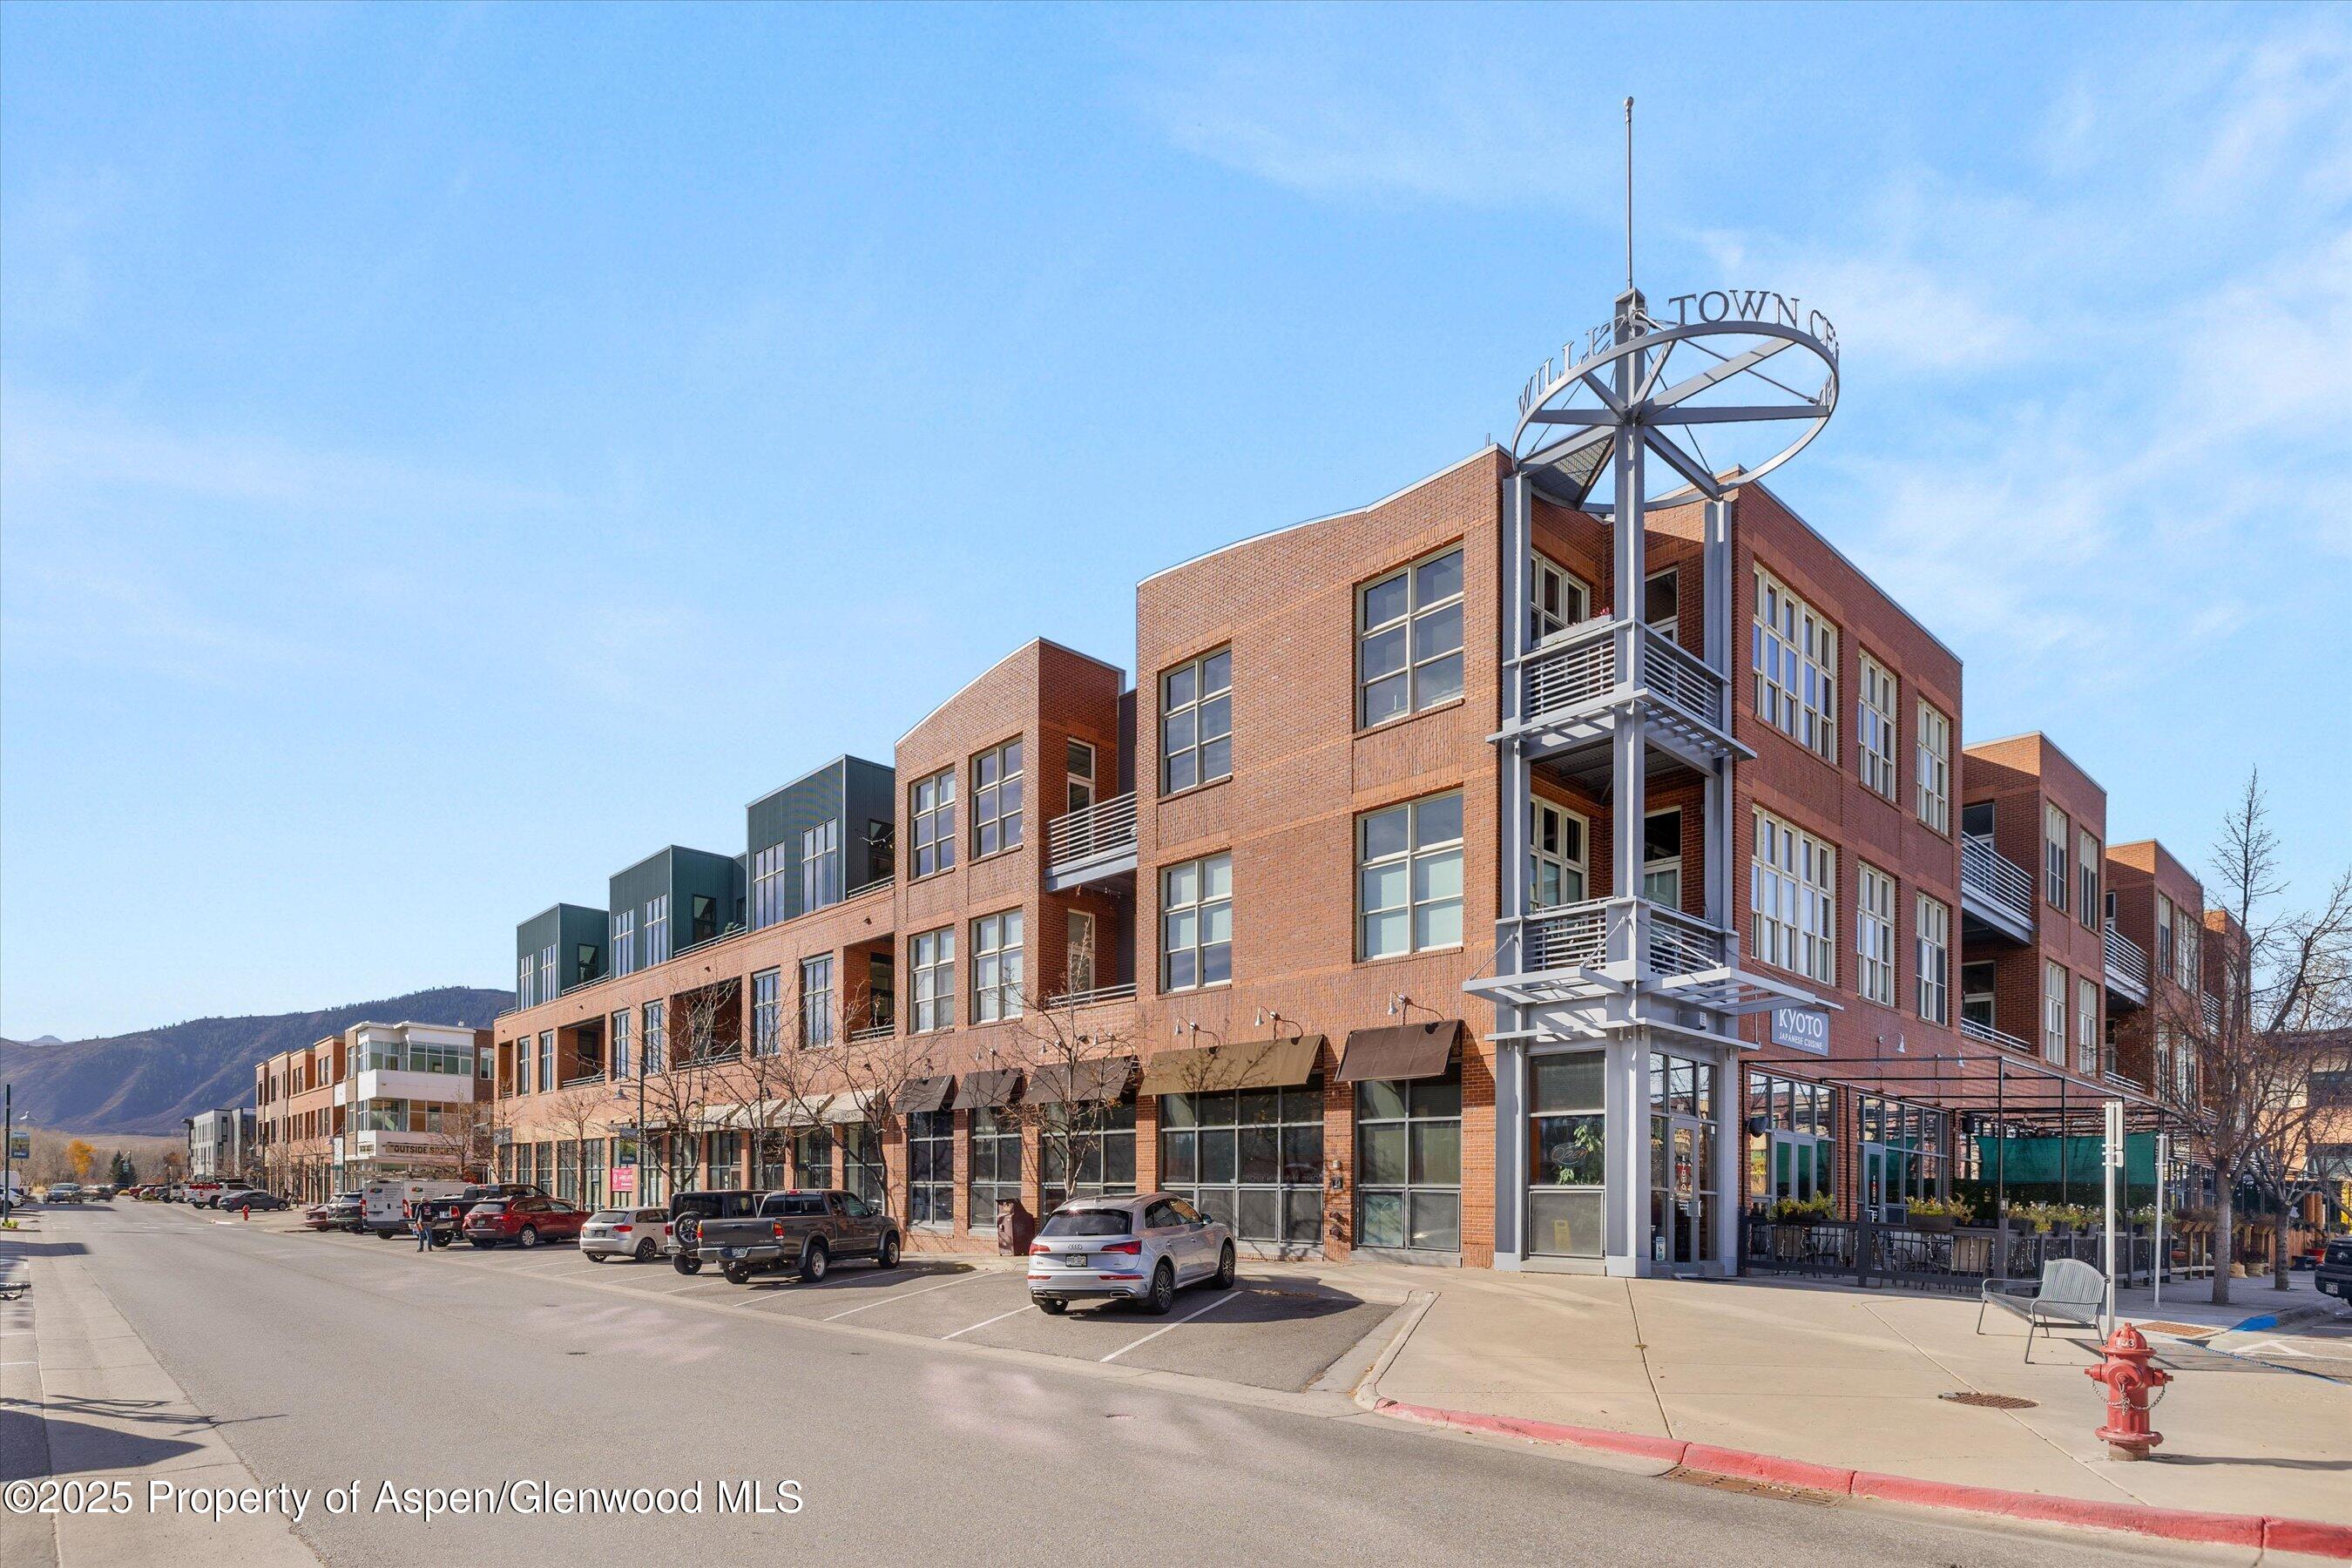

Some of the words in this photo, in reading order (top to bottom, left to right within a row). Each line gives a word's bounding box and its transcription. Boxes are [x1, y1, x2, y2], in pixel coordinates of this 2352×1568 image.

[1668, 290, 1800, 329] TOWN
[1779, 1008, 1822, 1038] KYOTO
[1779, 1031, 1803, 1045] JAPANESE
[1804, 1038, 1823, 1051] CUISINE
[394, 1144, 428, 1154] OUTSIDE
[1551, 1146, 1589, 1163] Open
